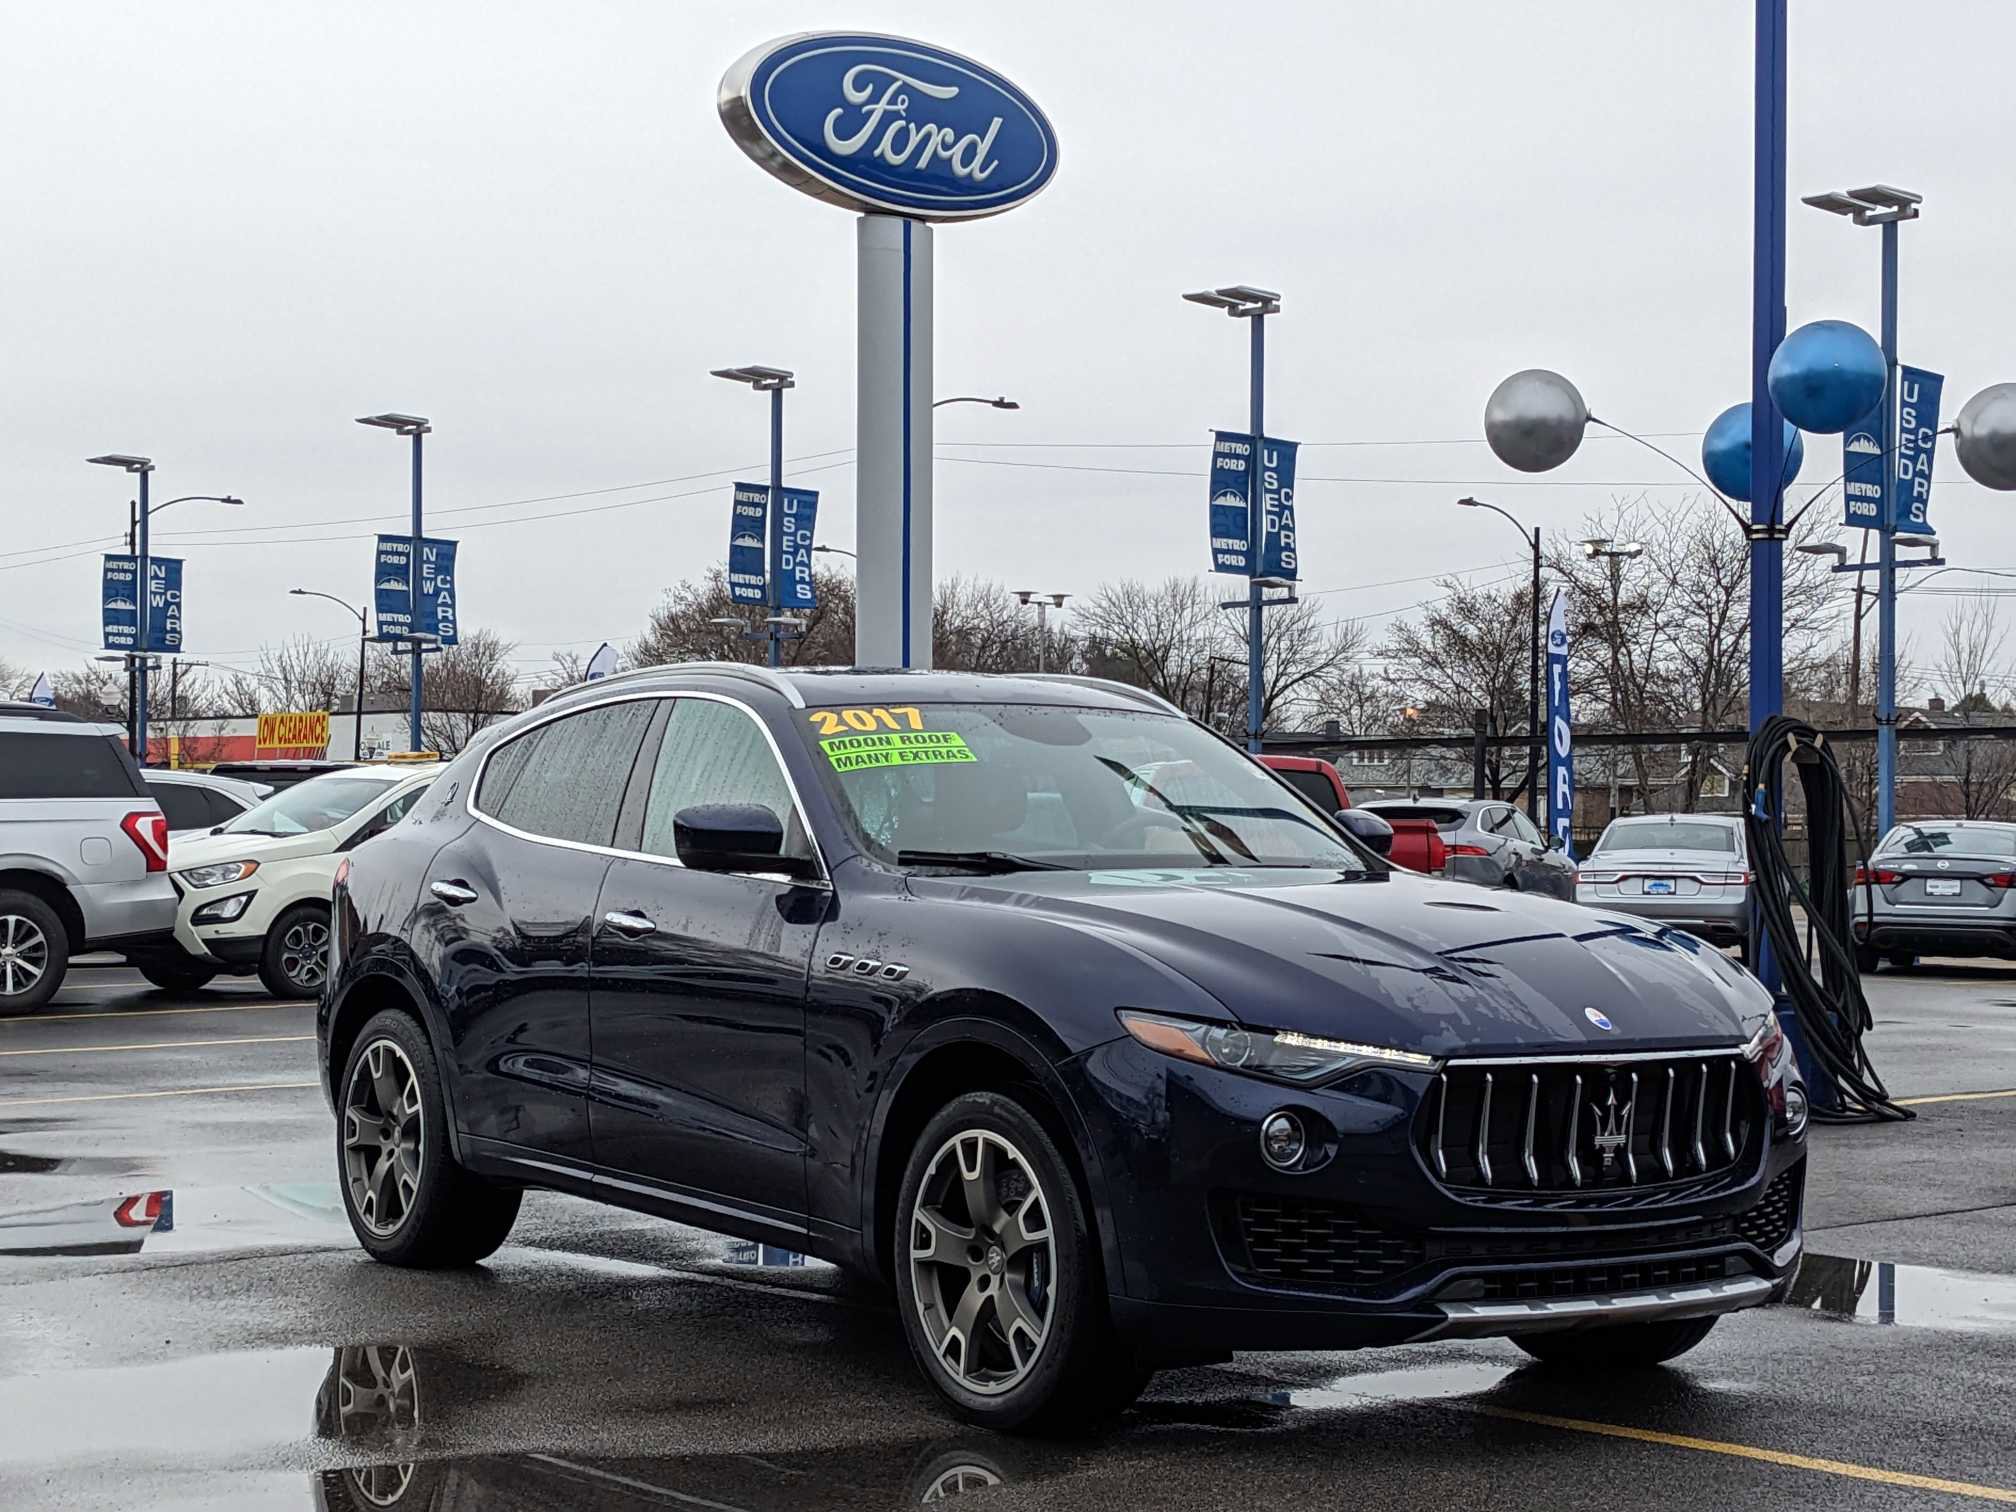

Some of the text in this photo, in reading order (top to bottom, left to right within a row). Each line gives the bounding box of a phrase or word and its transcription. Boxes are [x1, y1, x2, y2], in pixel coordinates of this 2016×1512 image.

[823, 64, 1003, 181] Ford
[1899, 381, 1919, 480] USED
[1216, 441, 1250, 455] METRO
[1217, 459, 1245, 471] FORD
[1910, 428, 1933, 523] CARS
[736, 491, 767, 503] METRO
[1264, 449, 1279, 533] USED
[1847, 481, 1881, 498] METRO
[736, 505, 762, 517] FORD
[1849, 501, 1877, 516] FORD
[782, 498, 798, 569] USED
[1281, 488, 1296, 568] CARS
[379, 542, 410, 553] METRO
[1213, 537, 1248, 551] METRO
[105, 561, 136, 571] METRO
[380, 554, 407, 565] FORD
[796, 531, 811, 599] CARS
[1218, 555, 1246, 566] FORD
[107, 572, 132, 581] FORD
[423, 547, 436, 594] NEW
[150, 564, 165, 608] NEW
[731, 573, 764, 585] METRO
[735, 587, 762, 598] FORD
[436, 575, 454, 636] CARS
[165, 590, 181, 646] CARS
[378, 613, 411, 624] METRO
[105, 625, 136, 635] METRO
[382, 624, 409, 635] FORD
[108, 636, 133, 646] FORD
[809, 708, 924, 735] 2017
[258, 715, 326, 745] LOW CLEARANCE
[828, 733, 954, 753] MOON ROOF
[836, 748, 970, 770] MANY EXTRAS
